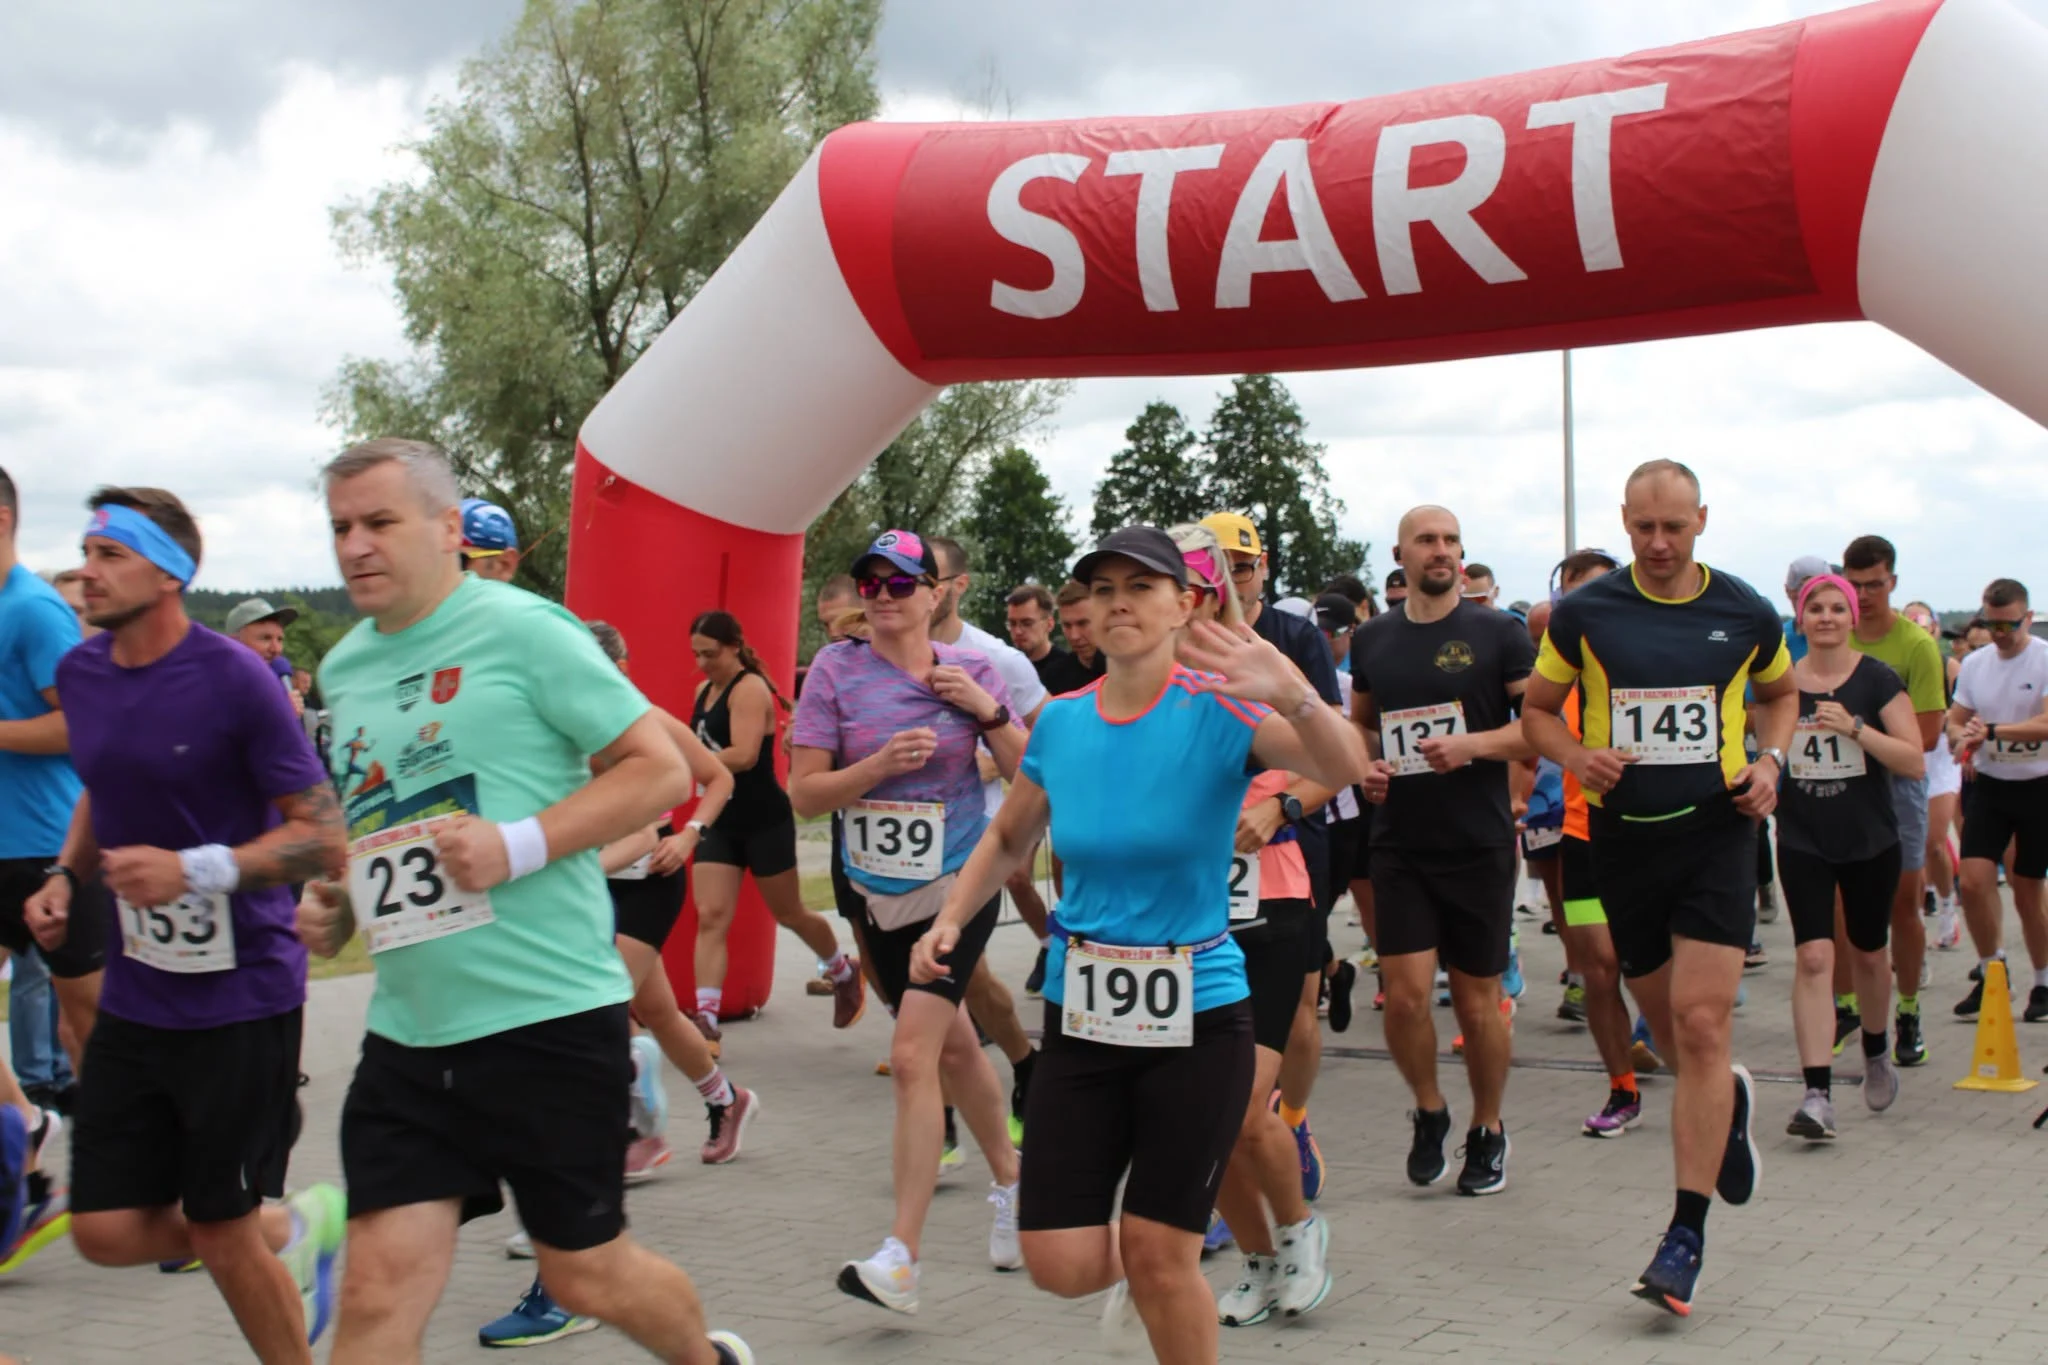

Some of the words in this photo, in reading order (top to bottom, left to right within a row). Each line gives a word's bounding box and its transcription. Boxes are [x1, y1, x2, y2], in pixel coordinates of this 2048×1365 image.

[986, 83, 1669, 319] START
[1390, 716, 1456, 757] 137
[1625, 702, 1708, 743] 143
[1803, 735, 1841, 763] 41
[853, 815, 934, 858] 139
[369, 846, 445, 918] 23
[1078, 963, 1180, 1020] 190
